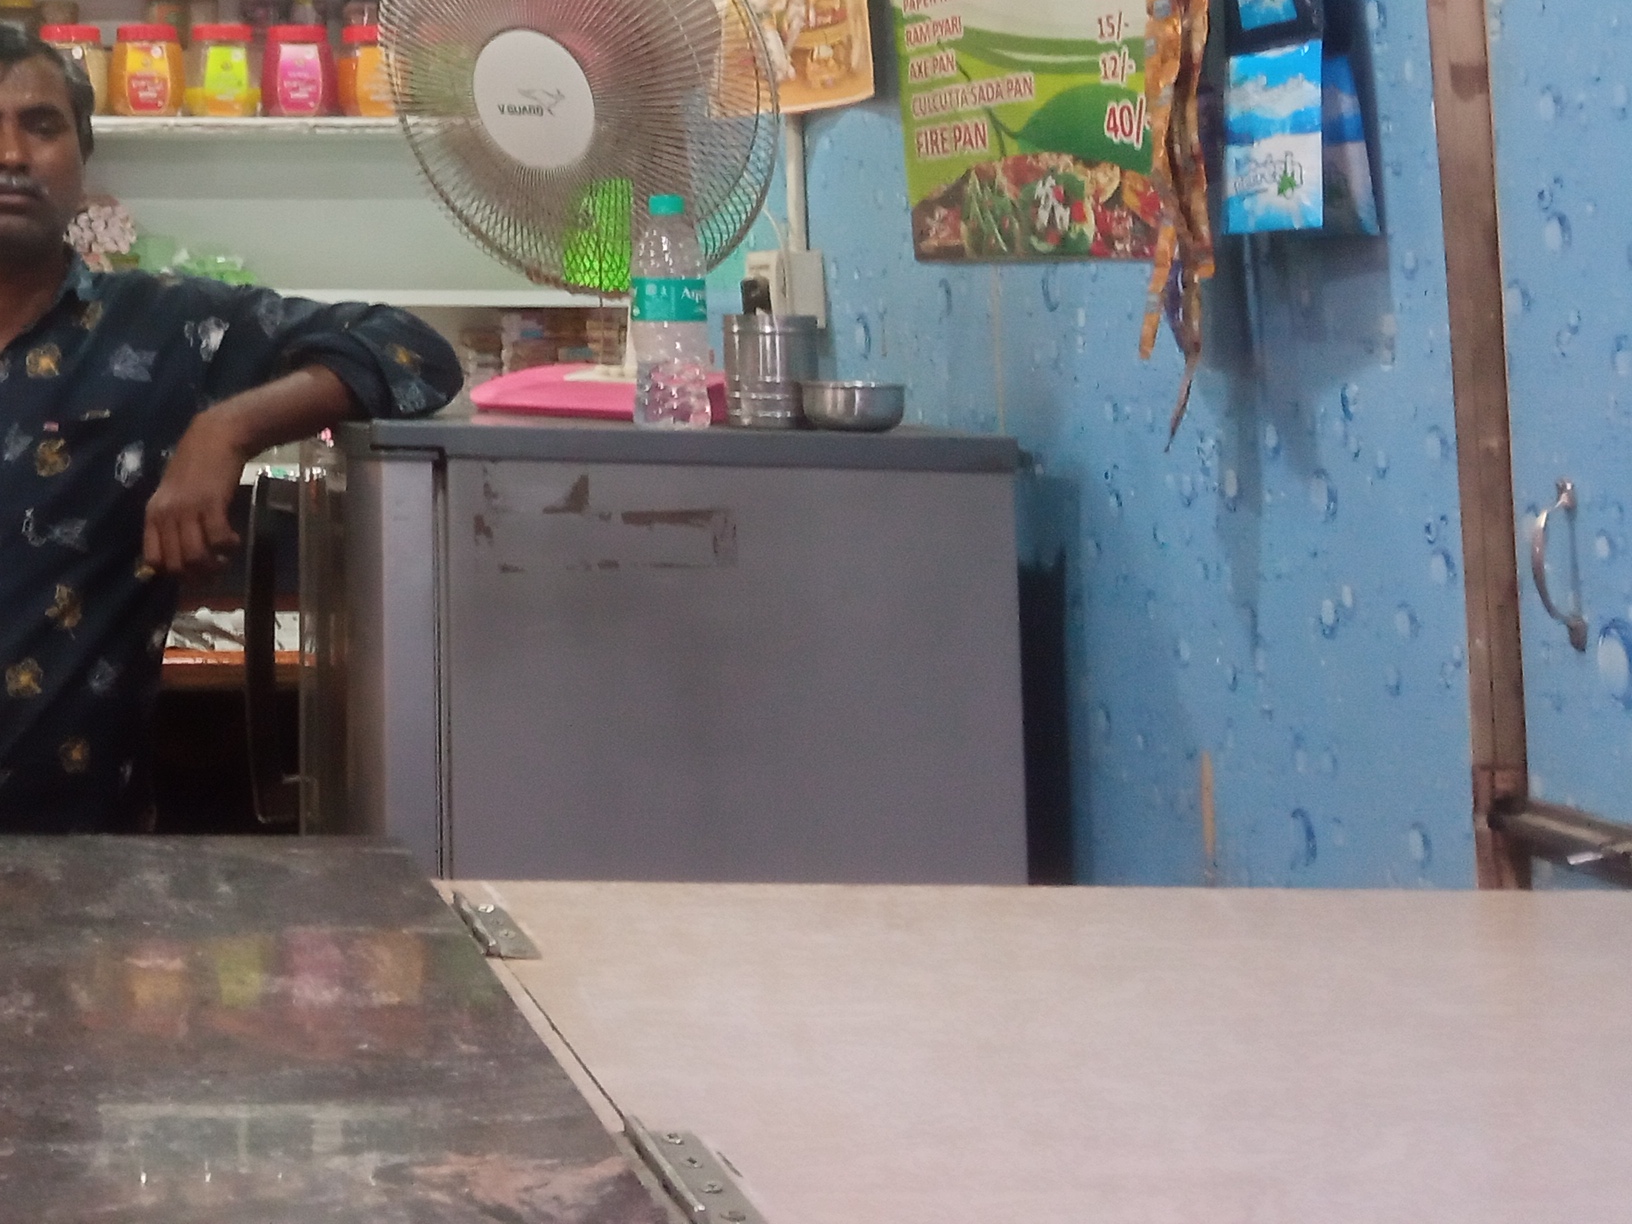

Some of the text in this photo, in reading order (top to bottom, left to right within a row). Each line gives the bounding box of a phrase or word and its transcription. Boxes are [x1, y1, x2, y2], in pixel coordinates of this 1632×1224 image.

[905, 16, 962, 47] RAM PYARI
[1097, 11, 1130, 41] 15/-
[909, 53, 955, 81] AXE PAN
[1100, 51, 1133, 82] 12/-
[912, 76, 1034, 118] CULCUTTA SADA PAN
[916, 123, 988, 157] FIRE PAN
